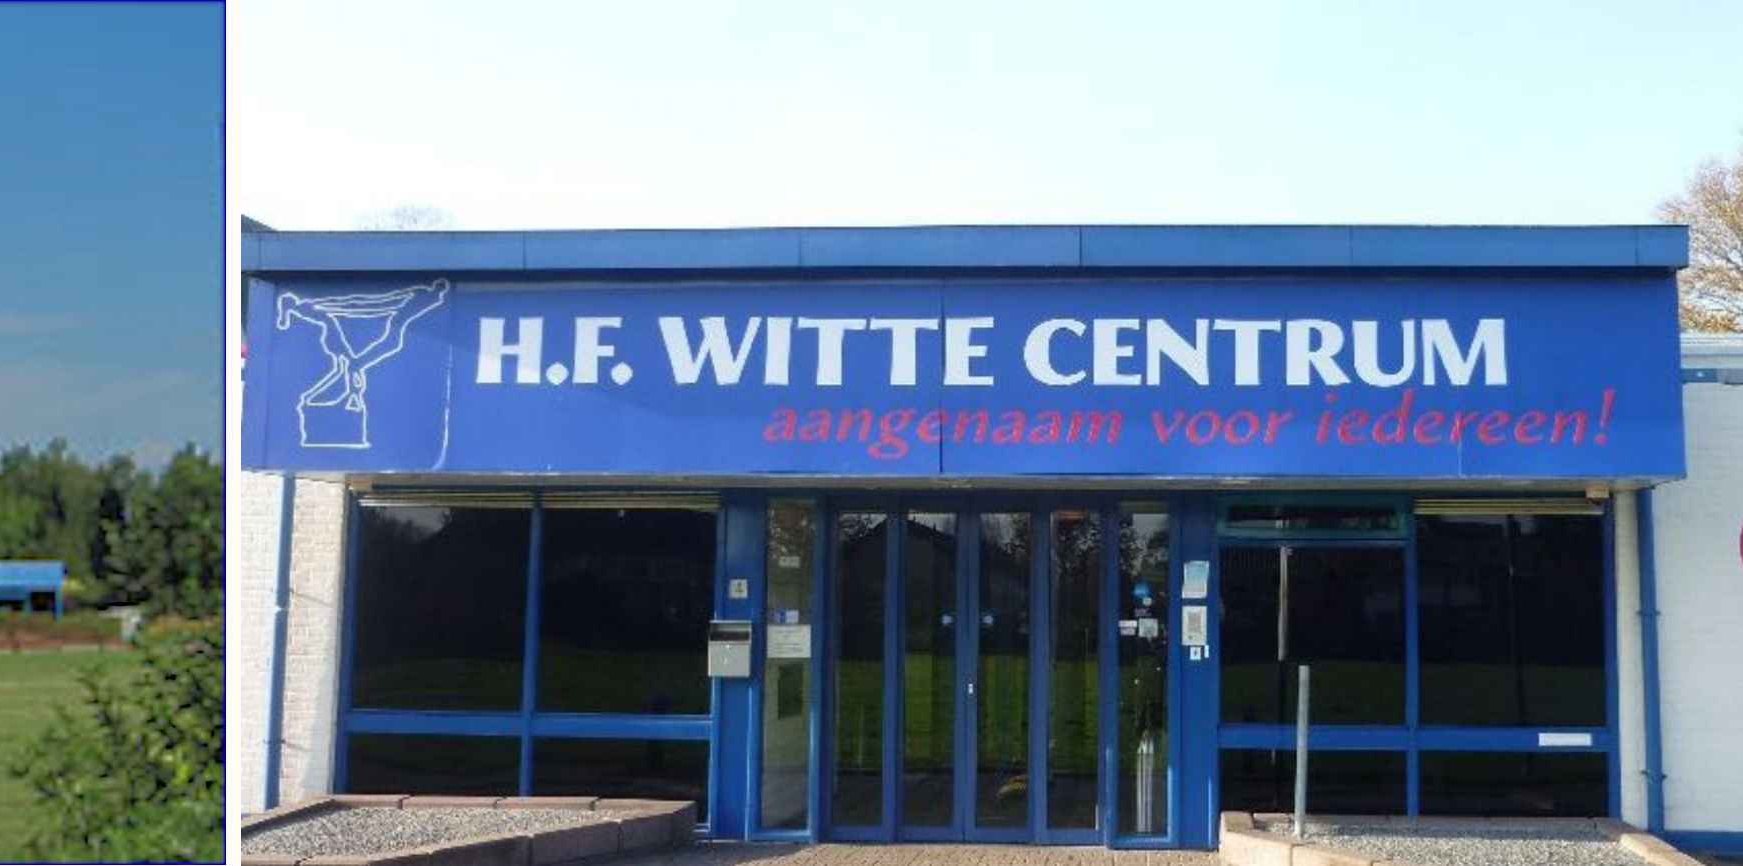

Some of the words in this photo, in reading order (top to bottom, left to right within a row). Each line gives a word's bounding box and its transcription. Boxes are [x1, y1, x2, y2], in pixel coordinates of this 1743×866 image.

[474, 315, 634, 387] H.F.
[657, 315, 995, 387] WITTE
[1022, 317, 1508, 388] CENTRUM
[764, 407, 1123, 459] aangenaam
[1151, 409, 1298, 445] voor
[1317, 388, 1616, 445] iedereen!
